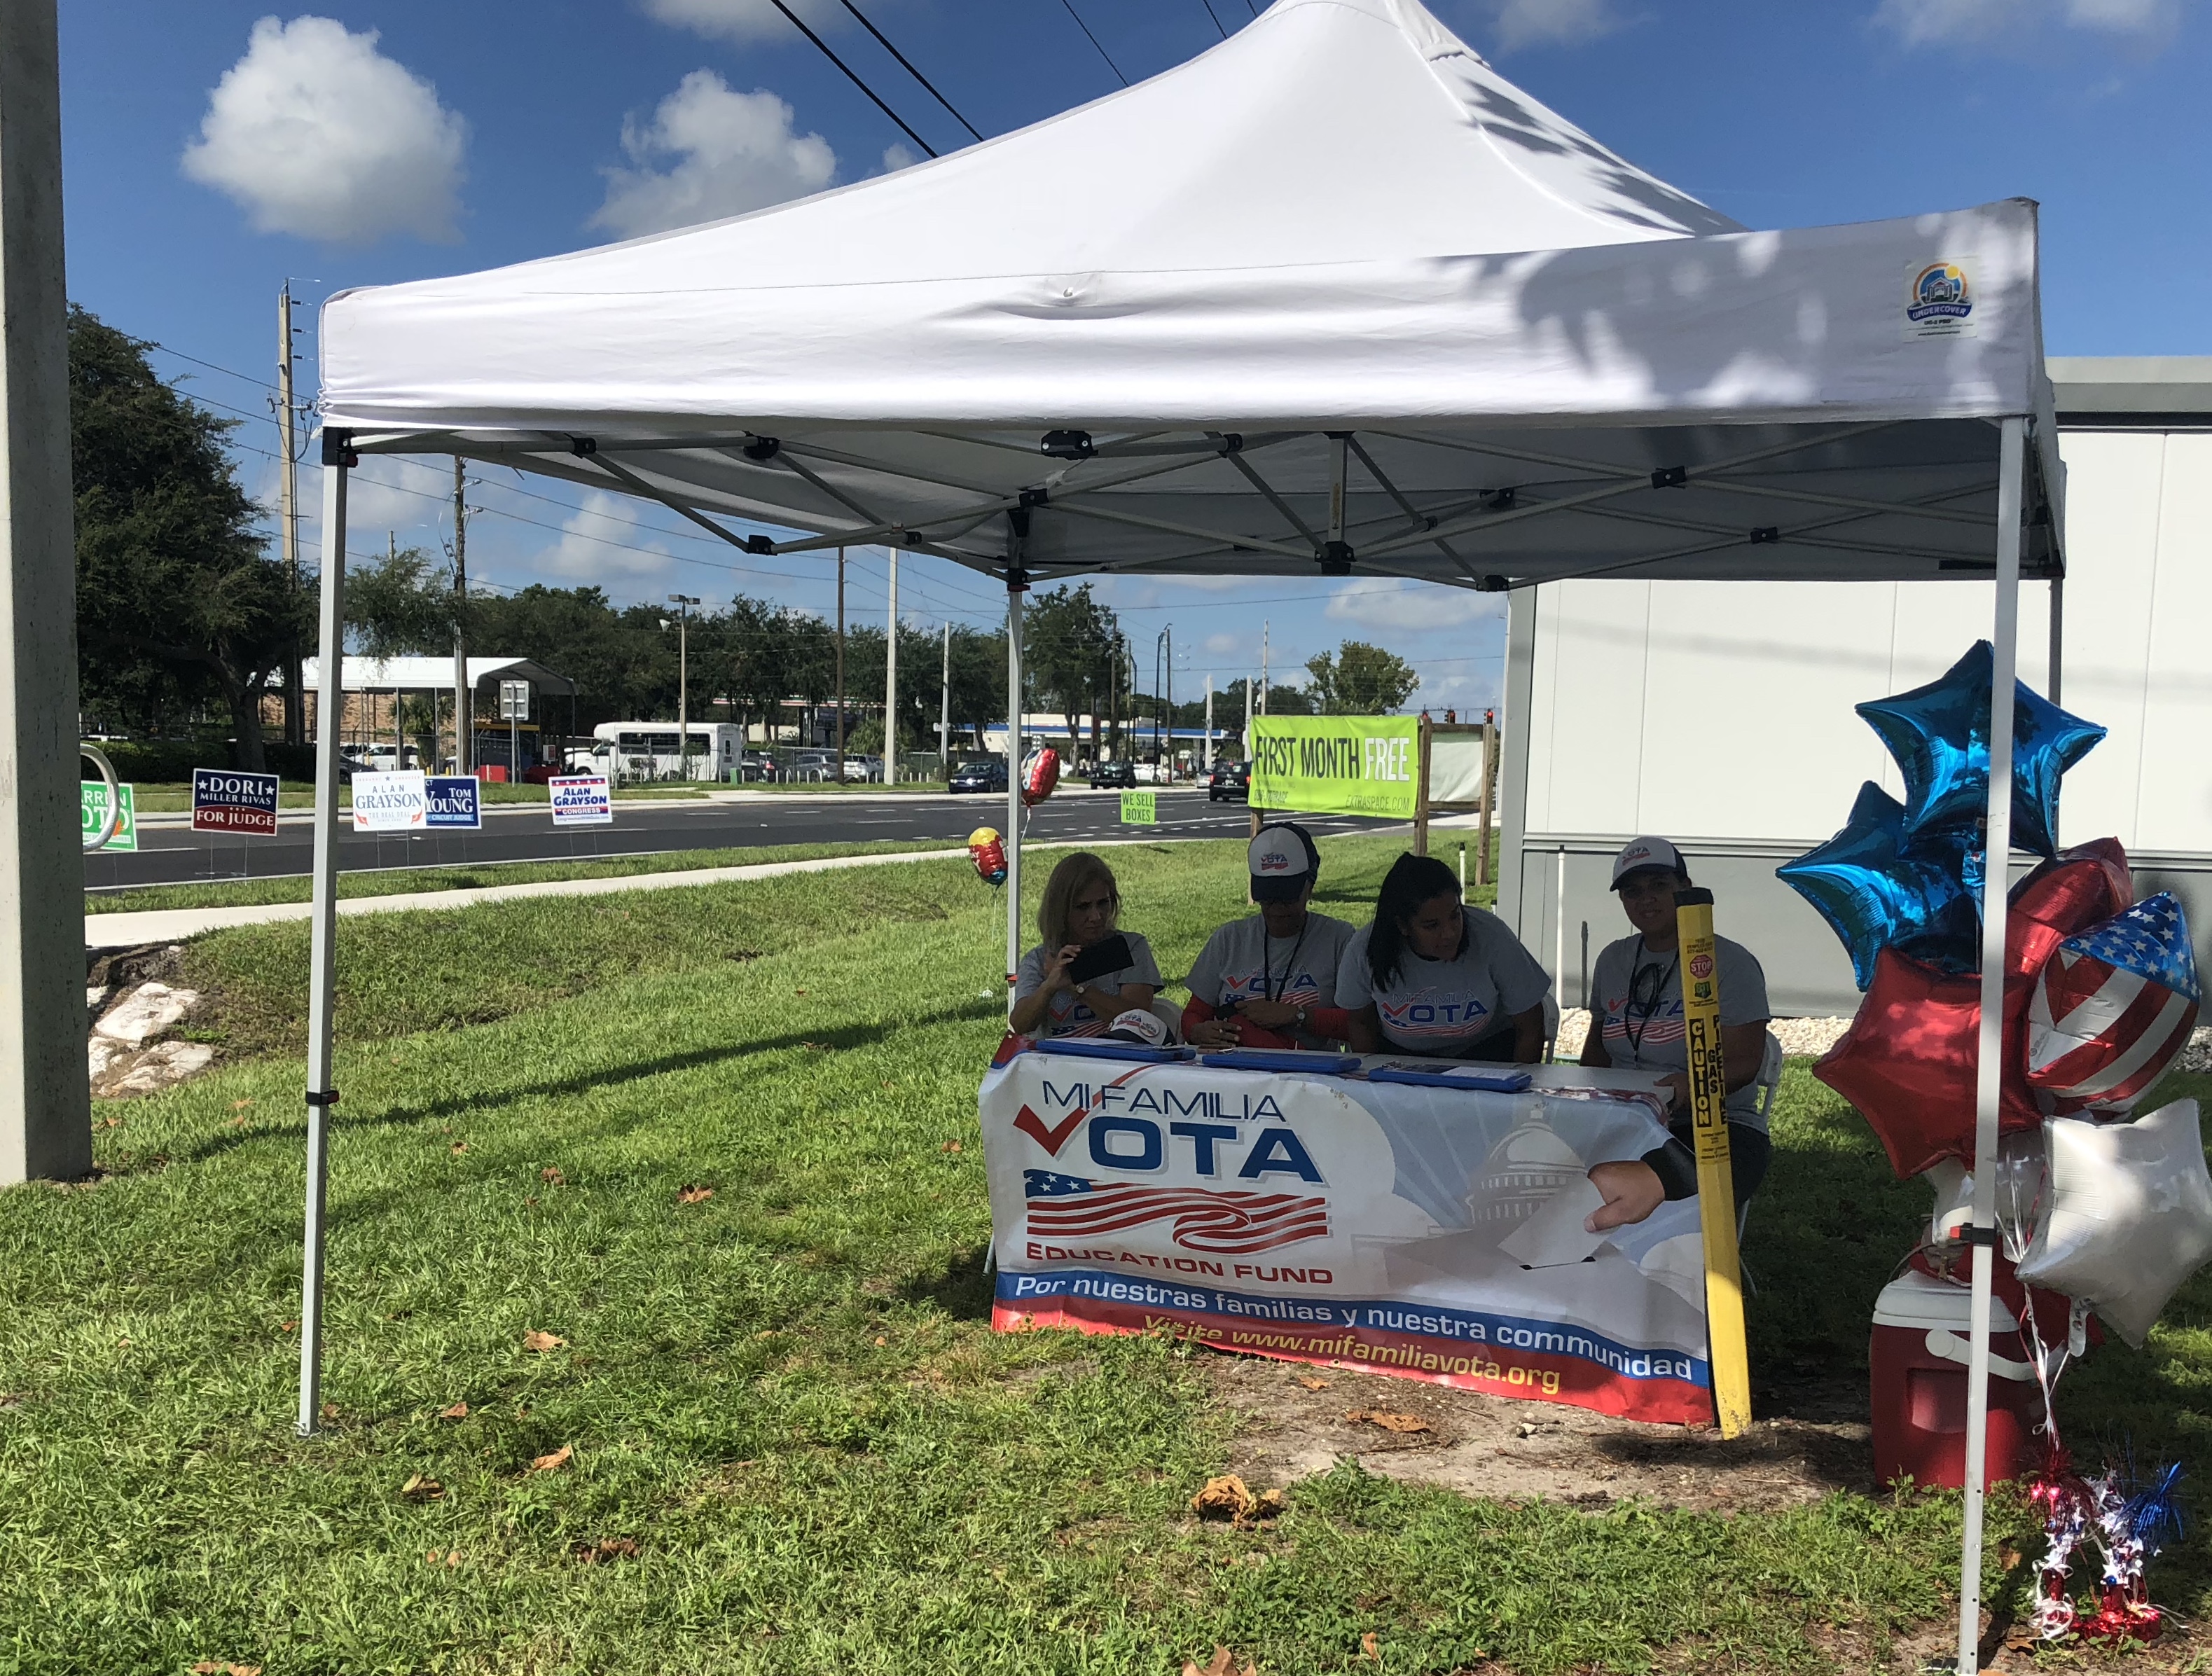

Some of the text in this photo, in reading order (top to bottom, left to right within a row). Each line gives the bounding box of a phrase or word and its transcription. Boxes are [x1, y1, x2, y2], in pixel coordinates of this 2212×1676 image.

[1912, 305, 1967, 319] UNDERCOVER
[1255, 736, 1410, 782] FIRST MONTH FREE
[209, 777, 263, 796] DORI
[372, 784, 405, 794] ALAN
[448, 787, 472, 798] TOM
[562, 787, 590, 796] ALAN
[200, 792, 271, 805] MILLER RIVAS
[355, 793, 422, 810] GRAYSON
[424, 791, 473, 813] YOUNG
[553, 796, 607, 806] GRAYSON
[1122, 793, 1154, 807] WE SELL
[1346, 794, 1410, 812] EXTRASPACE.COM
[196, 810, 274, 826] FOR JUDGE
[562, 807, 600, 815] CONGRESS
[1126, 808, 1151, 822] BOXES
[1690, 961, 1712, 972] STOP
[1392, 990, 1475, 1003] MI FAMILIA
[1381, 1000, 1488, 1022] VOTA
[1692, 1021, 1709, 1125] CAUTION
[1707, 1049, 1718, 1094] GAS
[1713, 1014, 1727, 1125] PIPELINE
[1042, 1080, 1287, 1123] MI FAMILIA
[1013, 1103, 1325, 1184] VOTA
[1025, 1241, 1334, 1284] EDUCATION FUND
[1016, 1276, 1692, 1381] Por nuestras familias y nuestra communidad
[1143, 1315, 1561, 1395] Visite www.mifamiliavota.org
